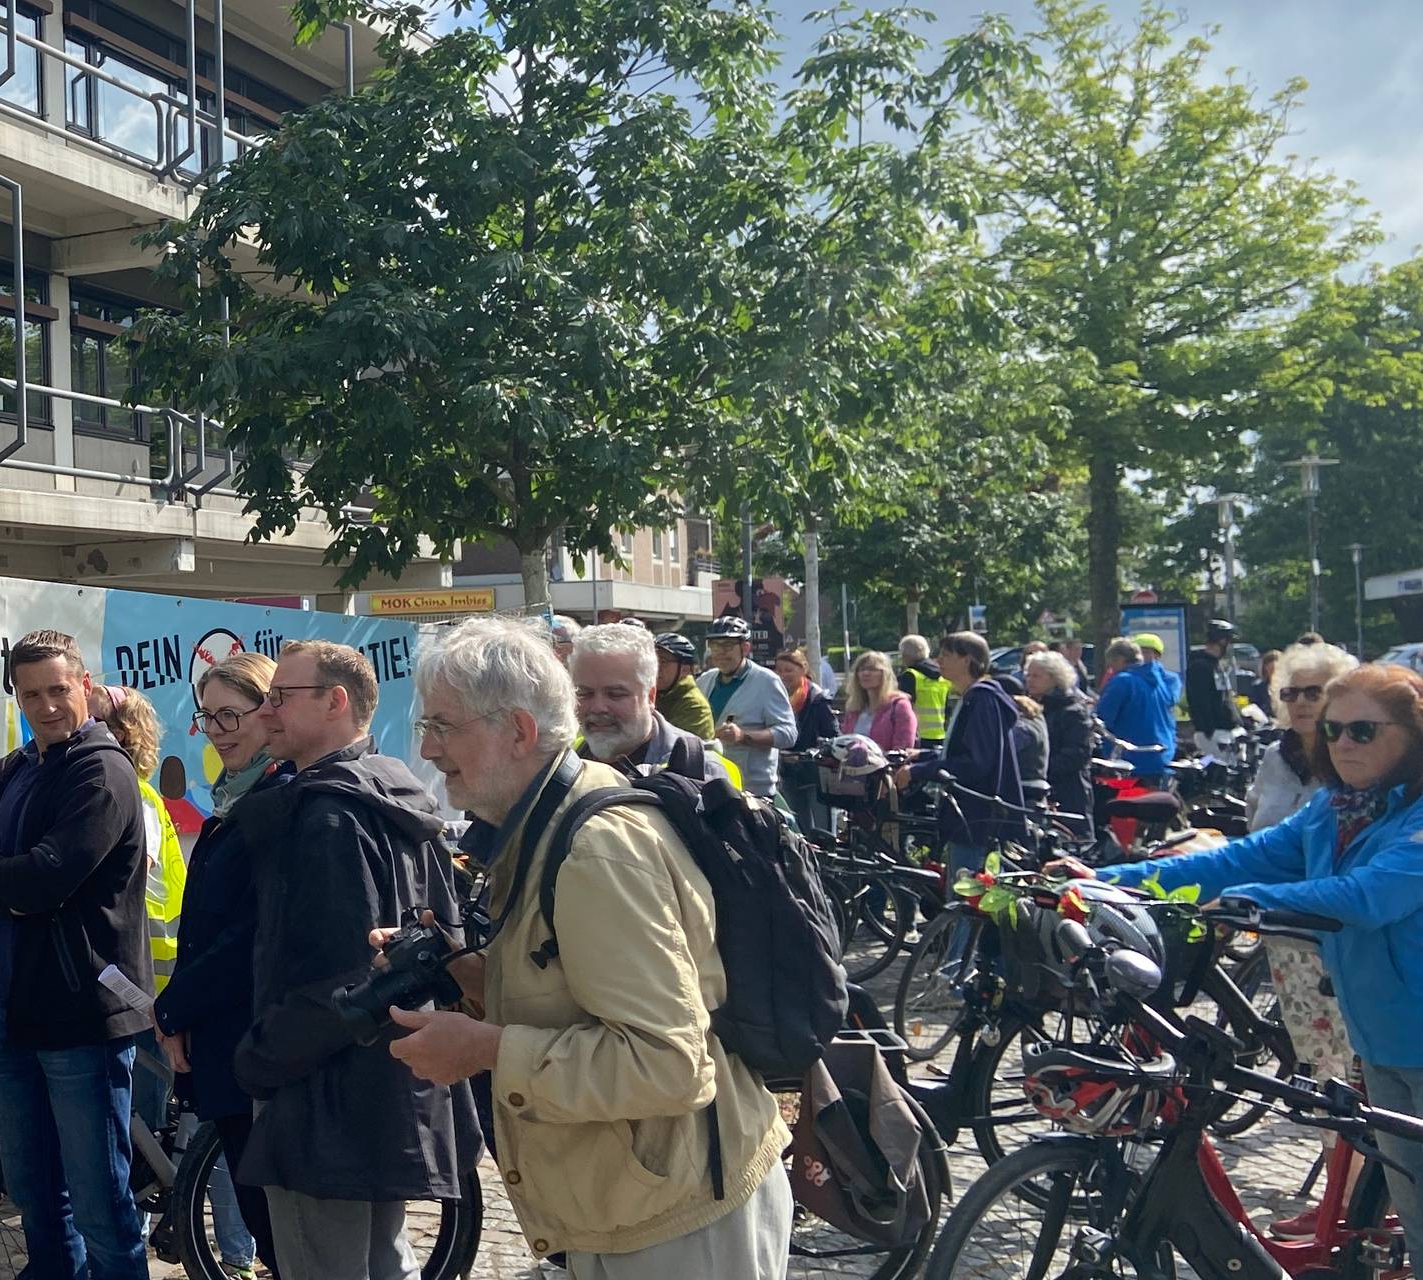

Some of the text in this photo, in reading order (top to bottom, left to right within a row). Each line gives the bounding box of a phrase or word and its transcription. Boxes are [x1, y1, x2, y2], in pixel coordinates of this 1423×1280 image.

[381, 595, 487, 609] MOK China Imbiss
[115, 634, 183, 690] DEIN
